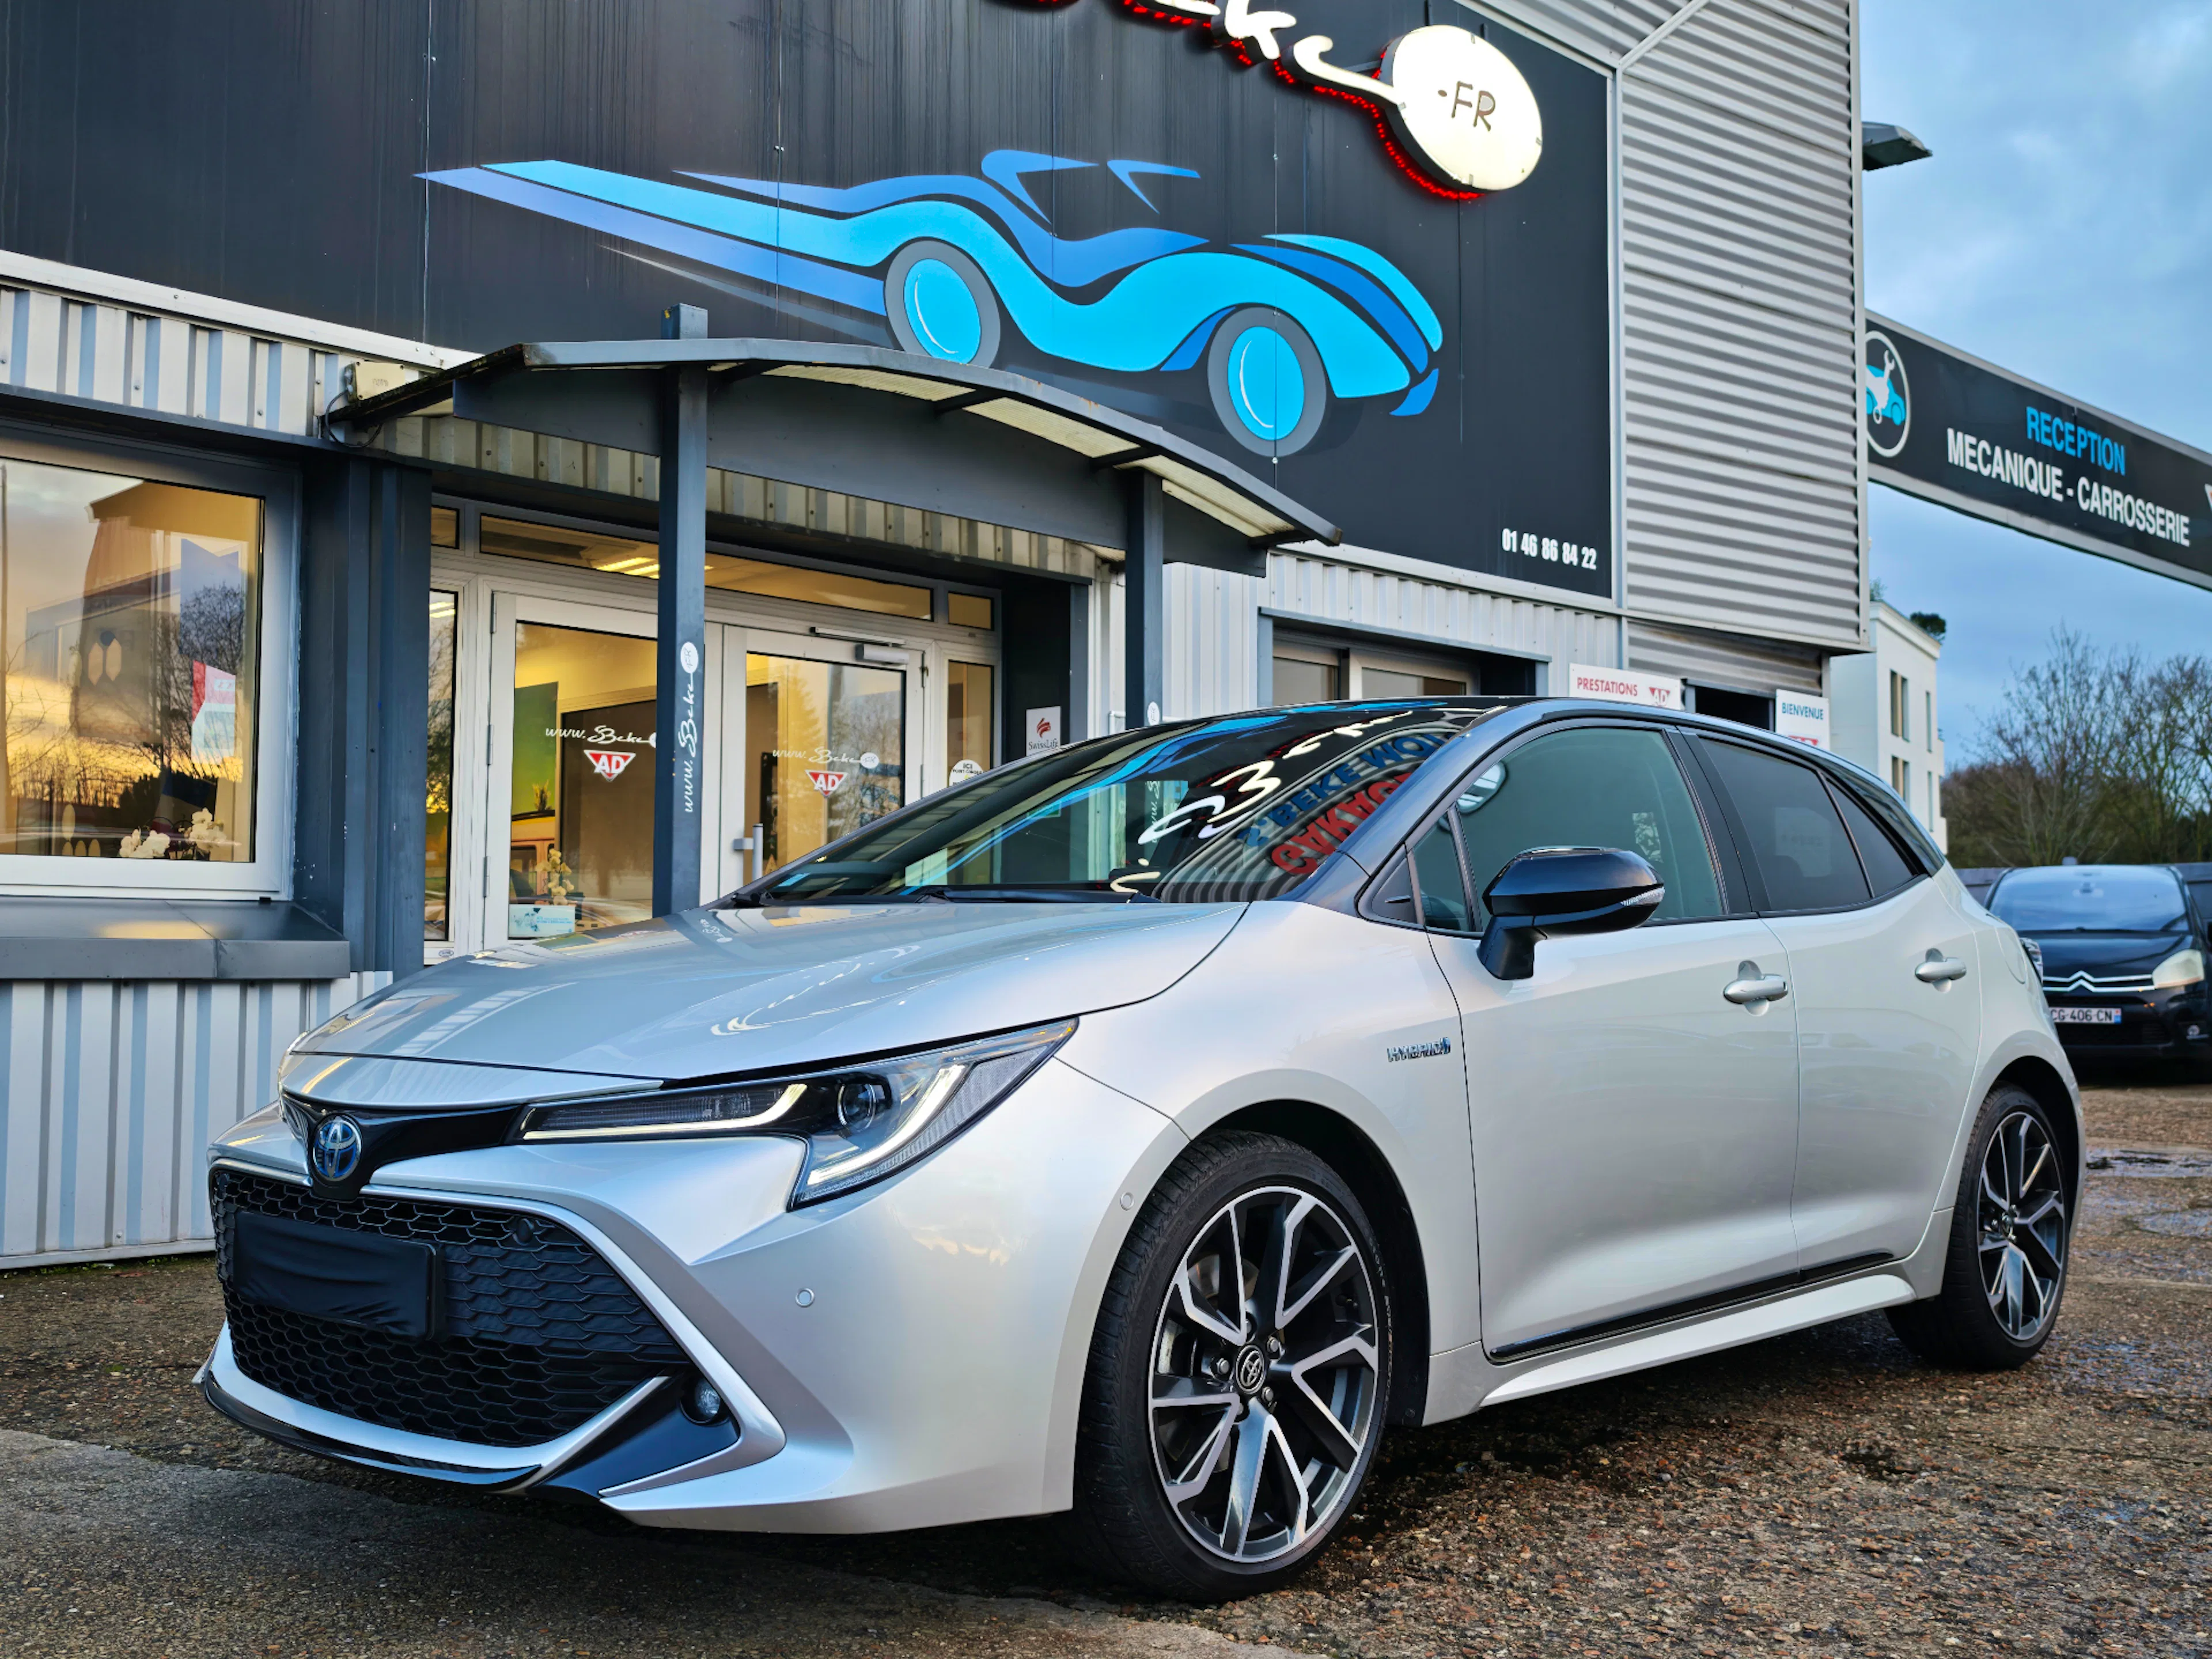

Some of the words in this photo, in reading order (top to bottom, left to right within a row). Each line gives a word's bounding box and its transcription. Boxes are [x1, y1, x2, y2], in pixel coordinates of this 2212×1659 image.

[2026, 406, 2126, 476] RECEPTION
[1947, 427, 2063, 502] MECANIQUE
[2077, 476, 2190, 547] CARROSSERIE
[1502, 528, 1517, 553] 01
[1521, 532, 1537, 557] 46
[1541, 537, 1558, 562] 86
[1562, 541, 1578, 566] 84
[1581, 546, 1597, 570] 22
[1577, 677, 1638, 696] PRESTATIONS
[1782, 702, 1823, 720] BIENVENUE
[594, 755, 626, 774] AD
[814, 774, 838, 791] AD
